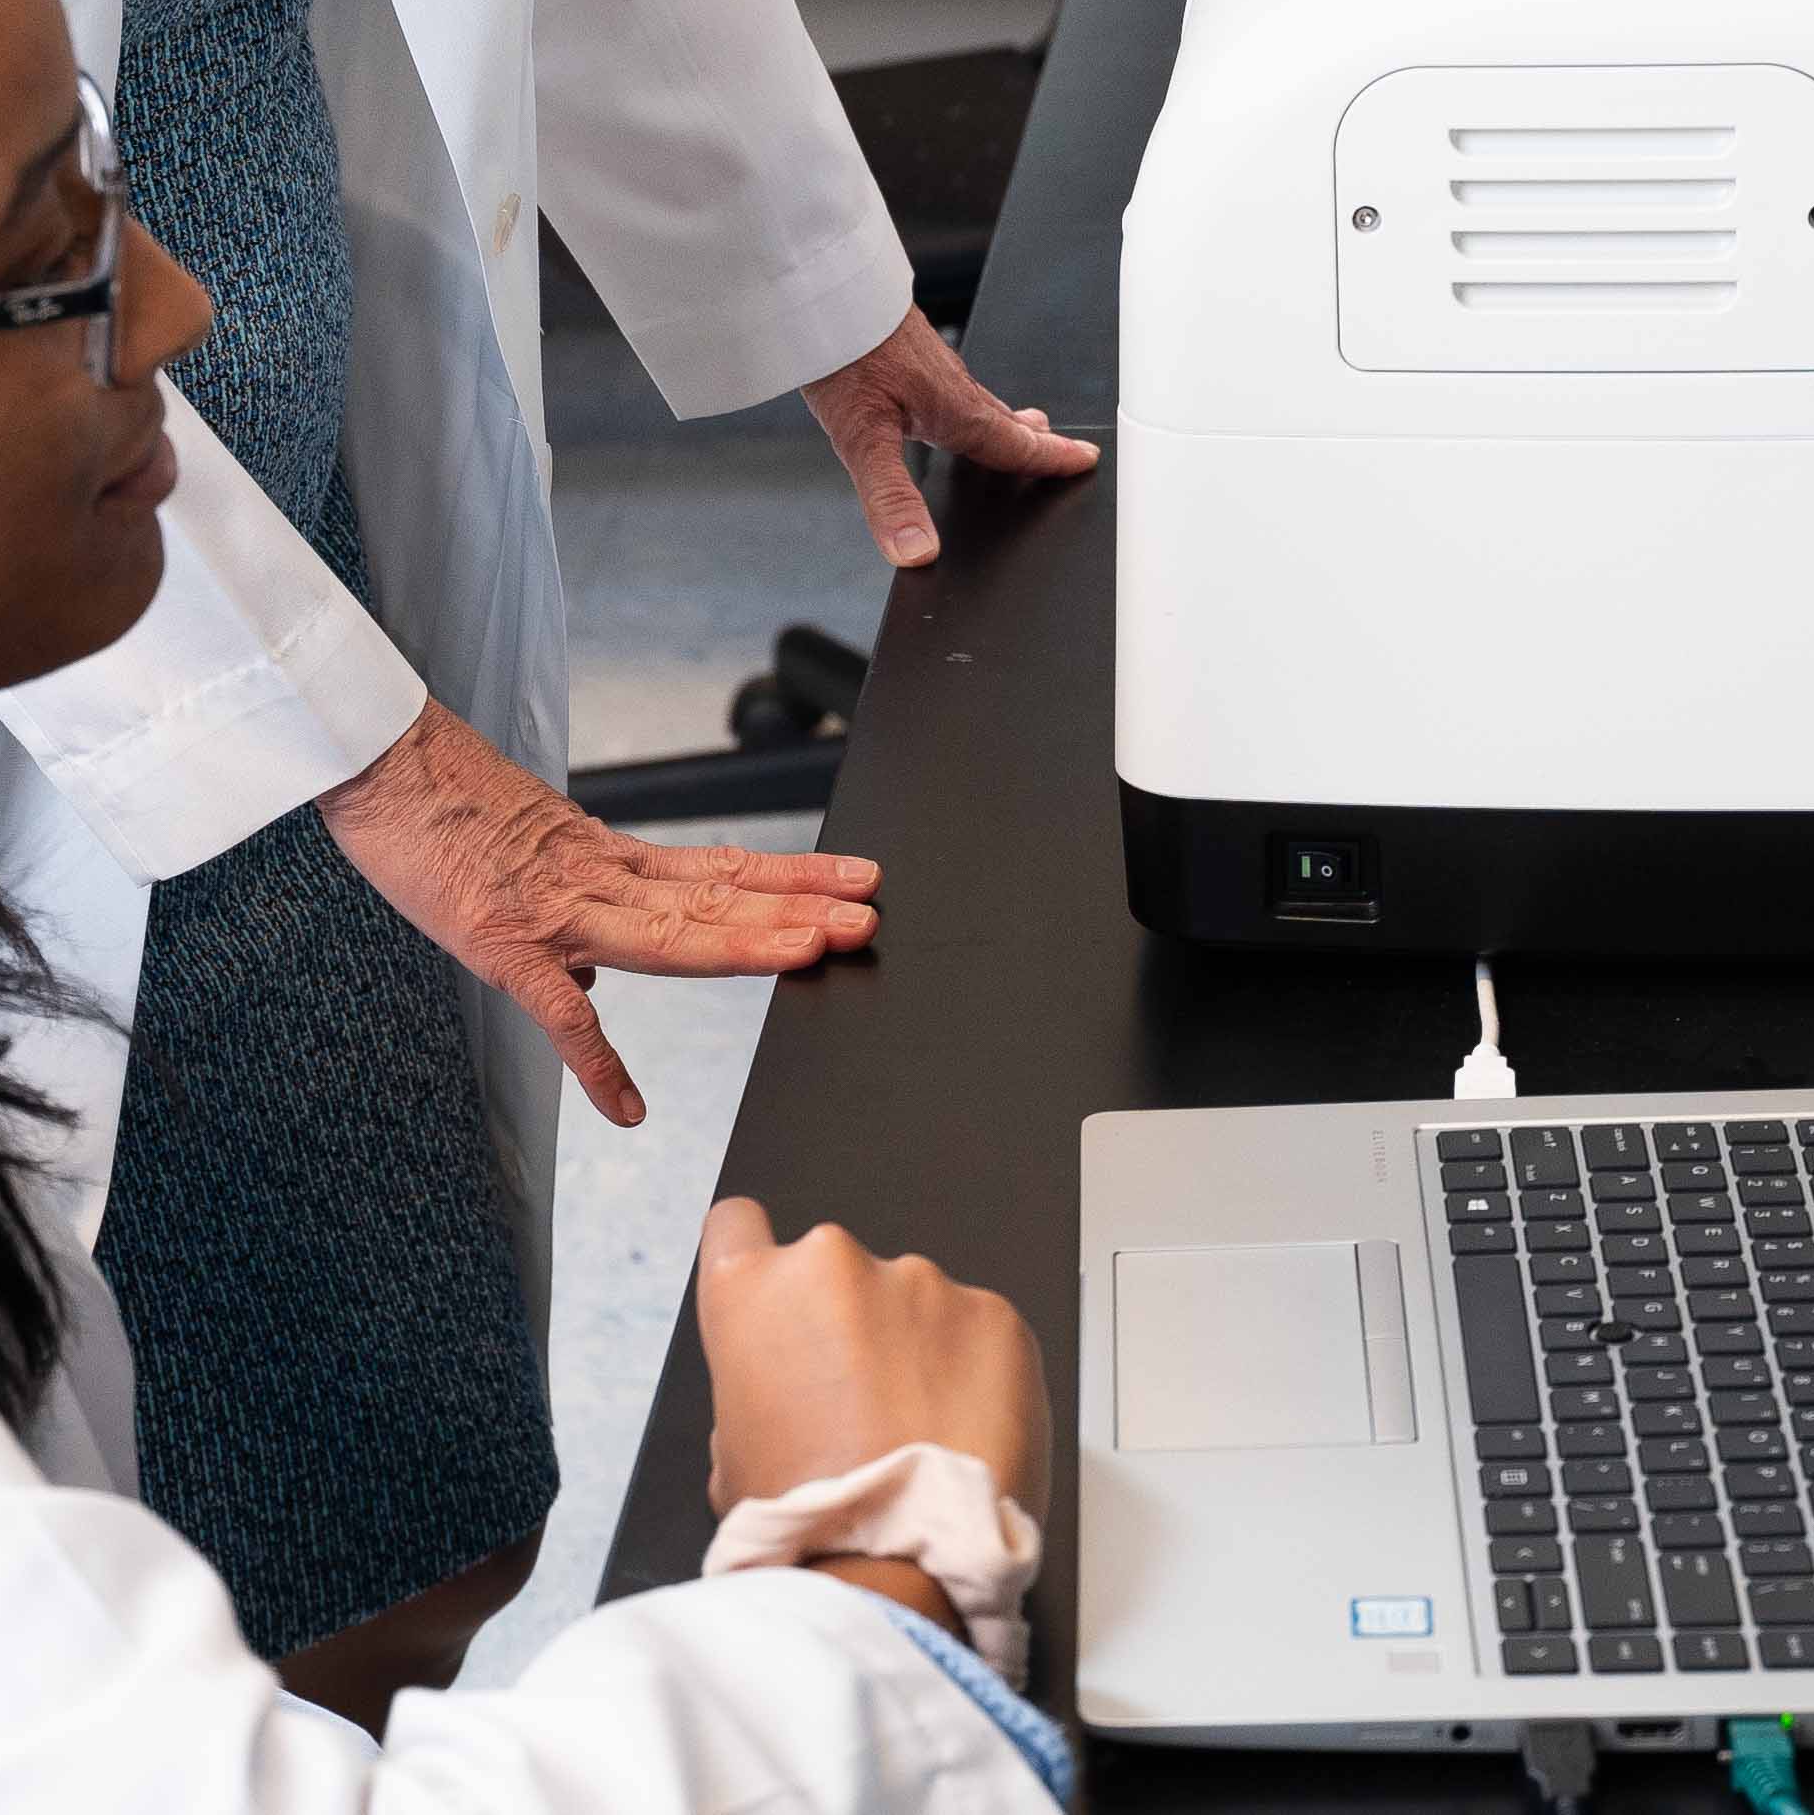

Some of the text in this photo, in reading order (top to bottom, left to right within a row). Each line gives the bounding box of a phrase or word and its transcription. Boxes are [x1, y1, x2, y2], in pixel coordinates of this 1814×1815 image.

[1621, 1176, 1636, 1184] A
[1699, 1198, 1714, 1208] W
[1632, 1238, 1649, 1246] D
[1560, 1257, 1577, 1265] C
[1566, 1289, 1582, 1298] V
[1721, 1293, 1737, 1301] T
[1645, 1303, 1662, 1312] G
[1566, 1322, 1584, 1331] B
[1728, 1326, 1744, 1335] Y
